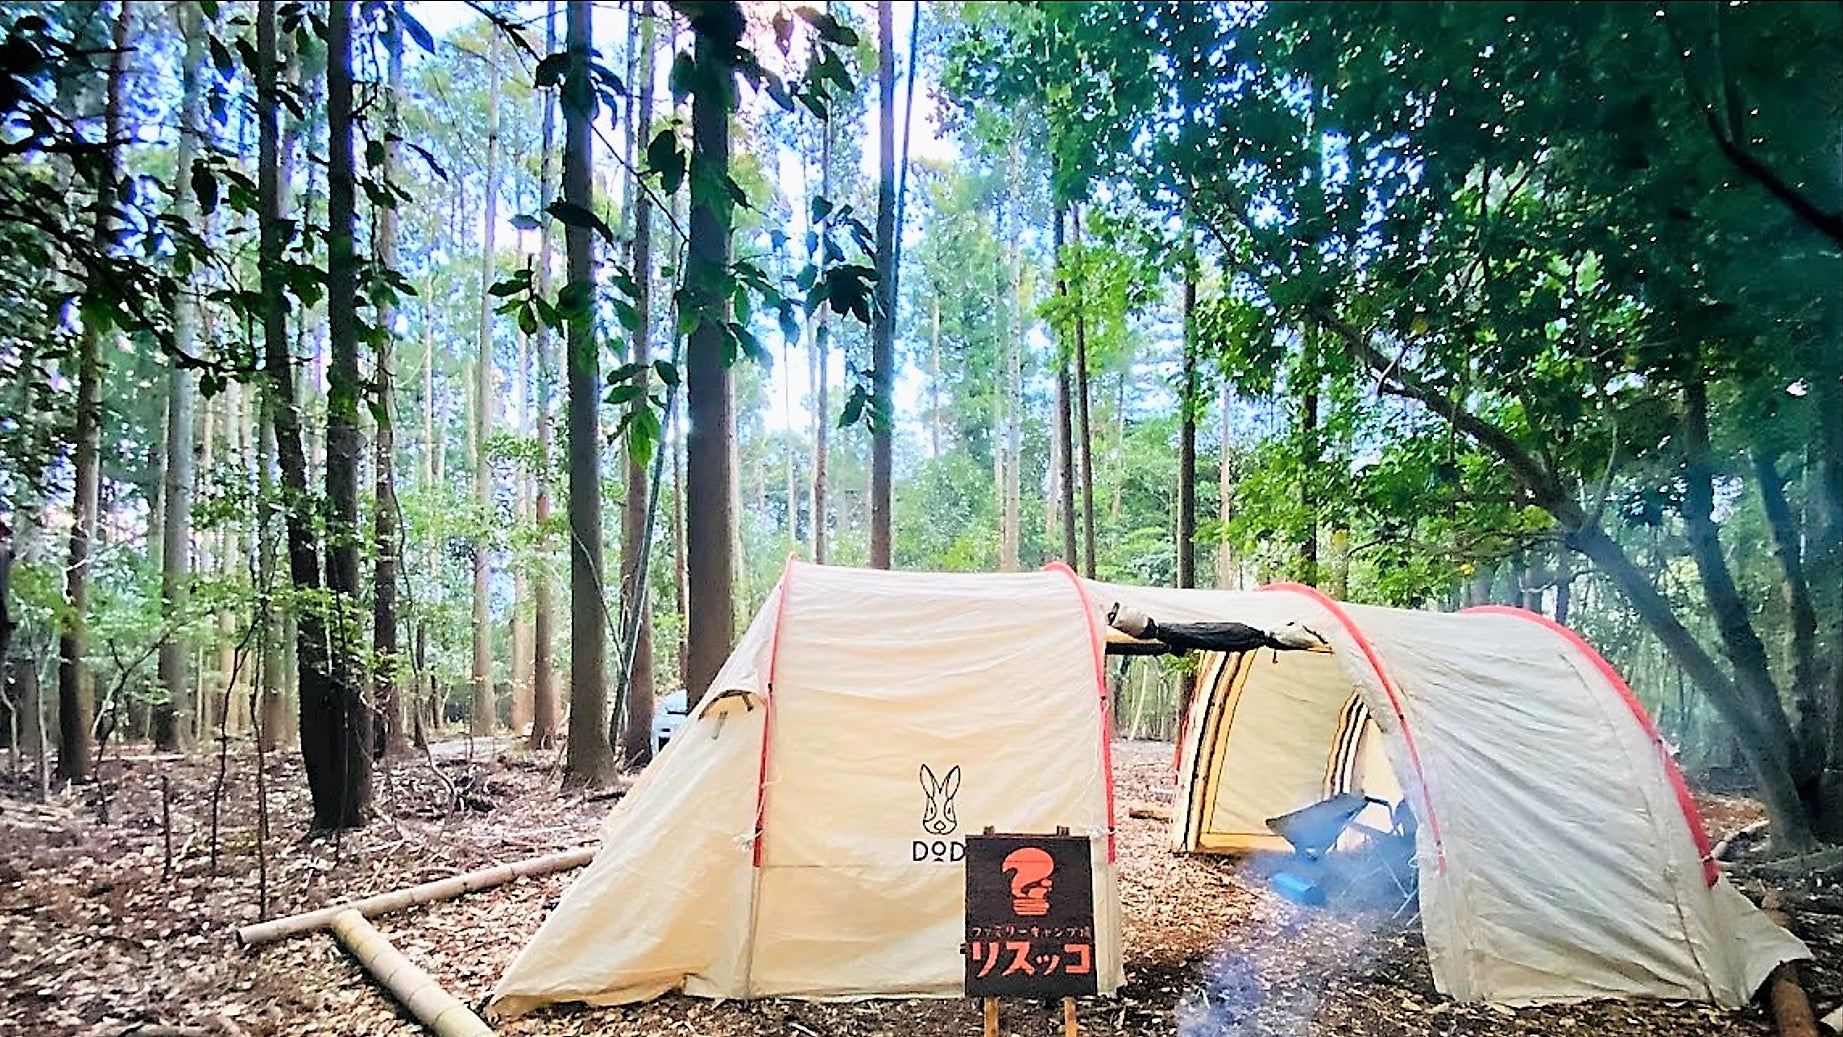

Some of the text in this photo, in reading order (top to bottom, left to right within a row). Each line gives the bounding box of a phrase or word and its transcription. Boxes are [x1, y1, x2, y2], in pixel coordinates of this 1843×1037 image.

[913, 841, 966, 862] DOD
[972, 941, 1091, 977] リスッコ
